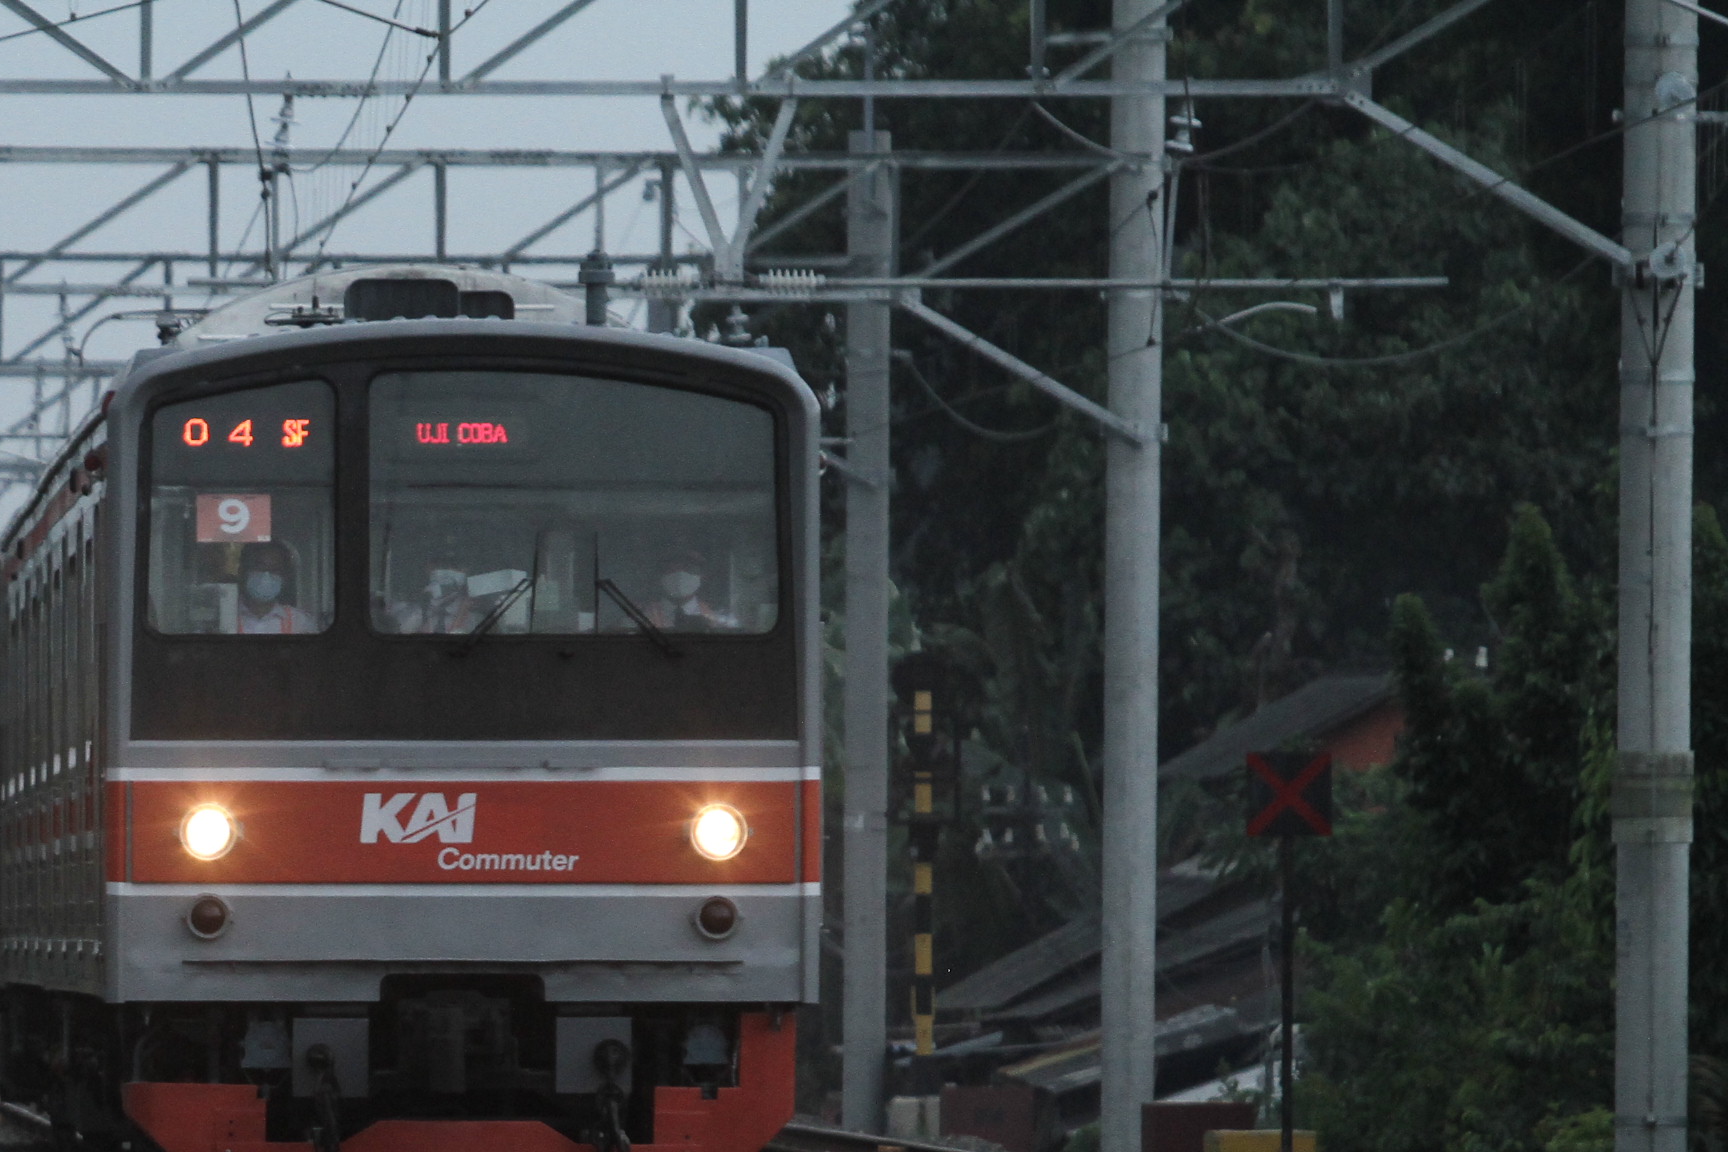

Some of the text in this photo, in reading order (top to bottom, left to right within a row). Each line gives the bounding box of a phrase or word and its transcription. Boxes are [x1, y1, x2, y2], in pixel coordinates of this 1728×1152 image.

[281, 419, 311, 447] SF
[416, 423, 509, 443] UJI COBA
[218, 498, 250, 534] 9
[360, 792, 477, 844] KAI
[437, 847, 580, 871] Commuter
